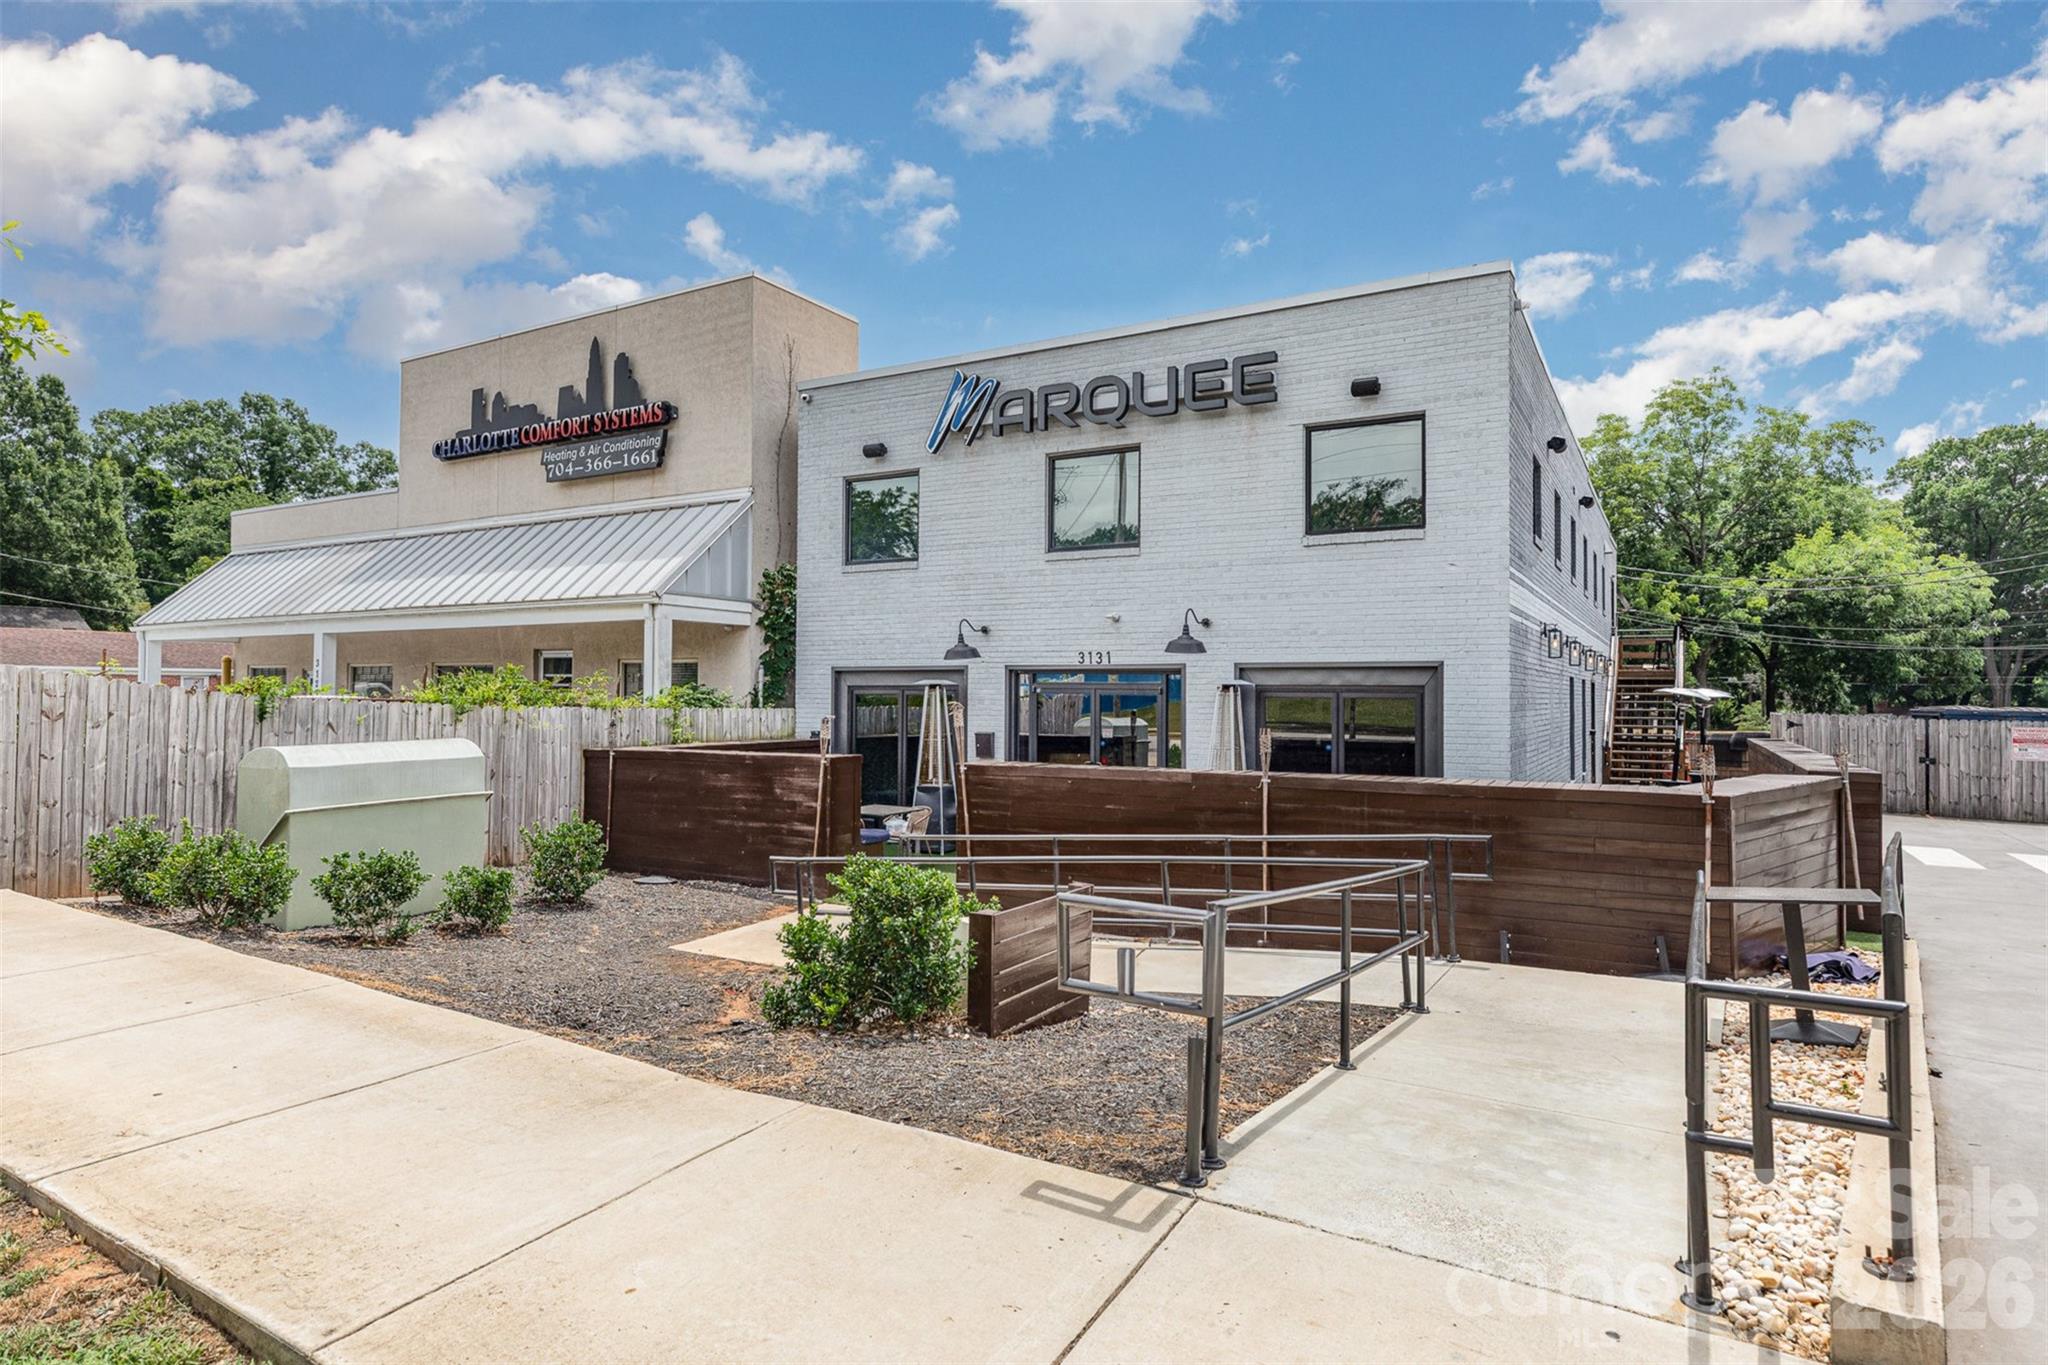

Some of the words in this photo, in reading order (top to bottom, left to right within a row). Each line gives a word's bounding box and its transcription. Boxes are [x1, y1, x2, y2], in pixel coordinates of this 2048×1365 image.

[925, 351, 1278, 454] MARQUEE
[432, 427, 519, 459] CHARLOTTE
[520, 413, 592, 445] COMFORT
[593, 401, 664, 433] SYSTEMS
[543, 448, 577, 463] Heating
[579, 446, 585, 457] &
[587, 444, 601, 456] Air
[602, 435, 661, 454] Conditioning
[547, 448, 657, 478] 704-366-1661
[1077, 651, 1111, 664] 3131
